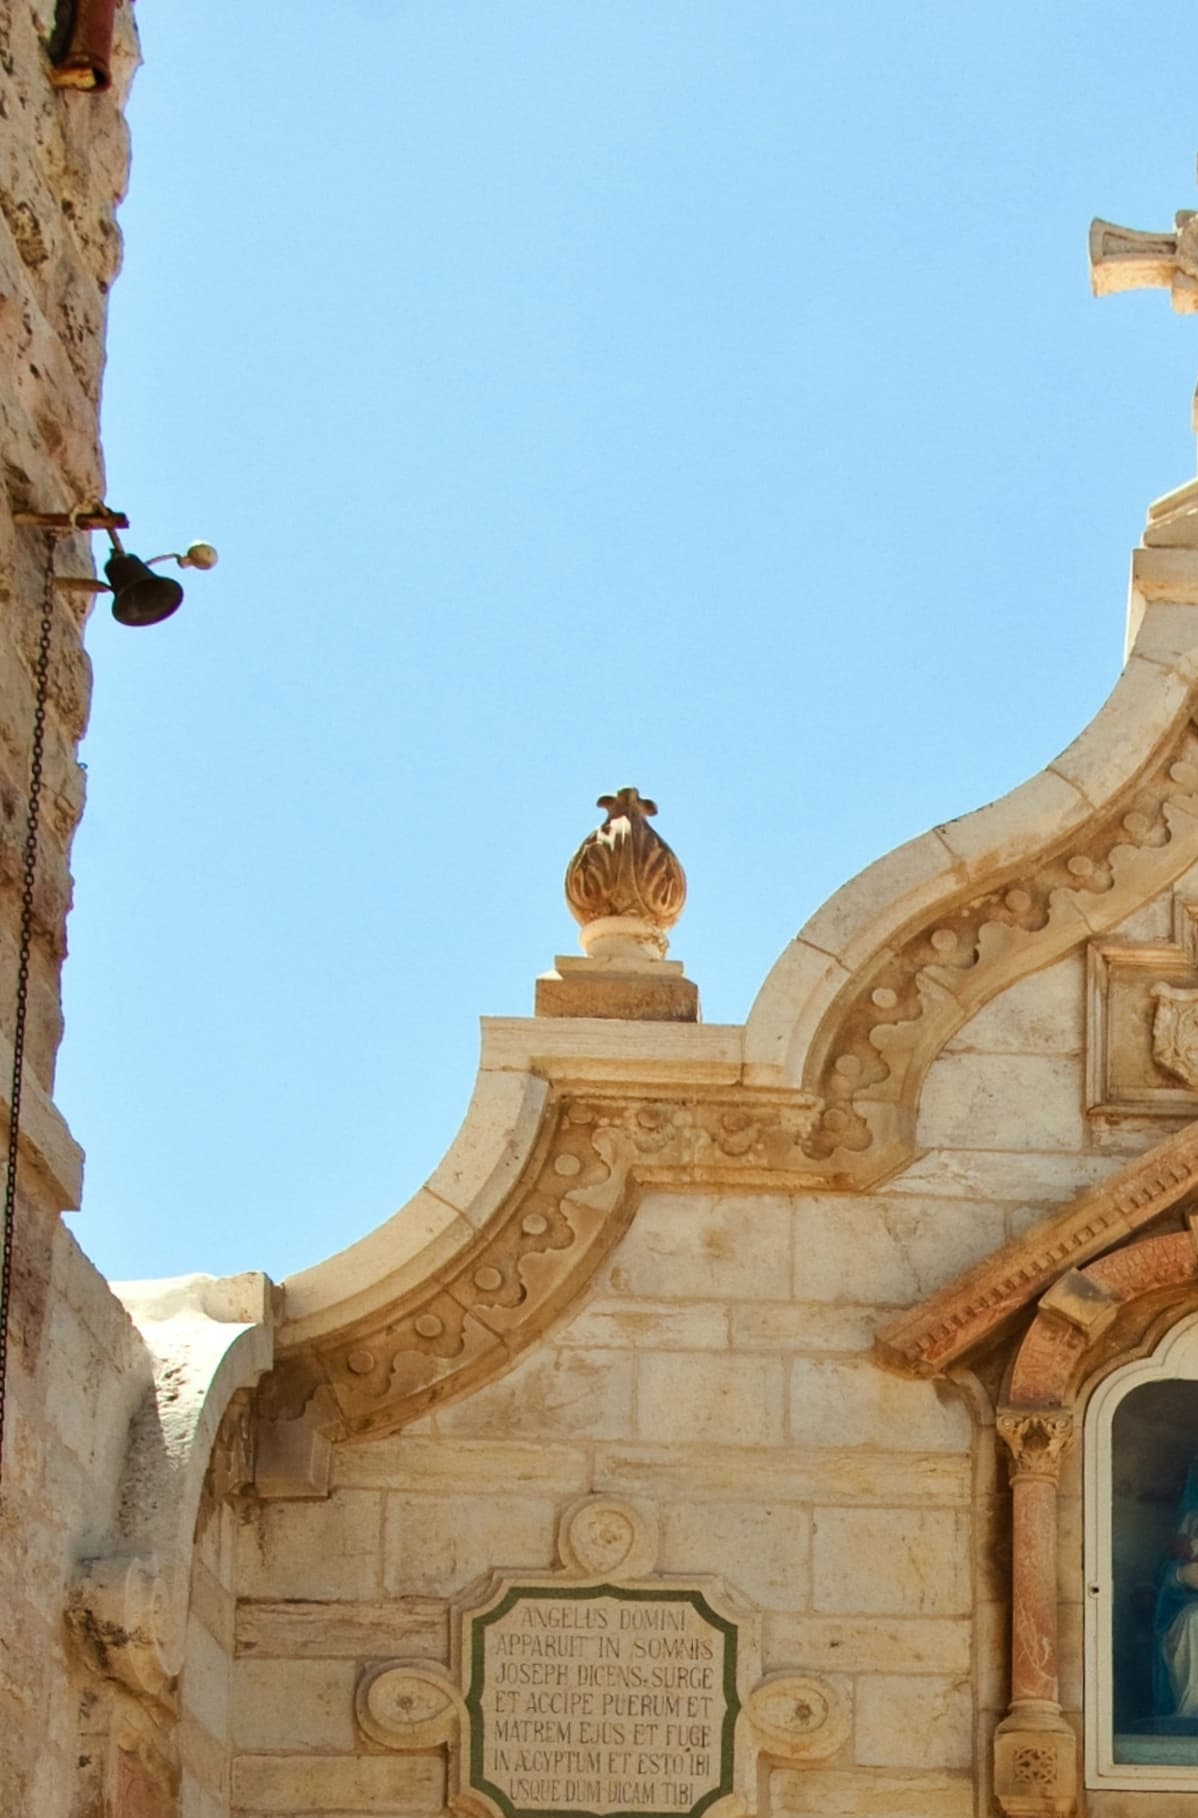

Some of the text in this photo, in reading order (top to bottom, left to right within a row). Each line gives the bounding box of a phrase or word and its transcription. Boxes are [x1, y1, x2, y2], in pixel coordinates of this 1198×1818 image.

[521, 1607, 686, 1630] ANGELUS DOMINI
[496, 1634, 590, 1658] APPARUIT
[599, 1636, 620, 1658] IN
[496, 1663, 568, 1686] JOSEPH
[652, 1666, 713, 1690] SURGE
[495, 1691, 712, 1718] ET ACCIPE PUERUM ET
[494, 1720, 712, 1748] MATREM EJUS ET FUGE
[494, 1749, 509, 1771] IN
[608, 1753, 632, 1775] ET
[638, 1753, 684, 1776] ESTO
[690, 1754, 710, 1776] IBI
[510, 1778, 694, 1806] USQUE DUM DICAM TIBI
